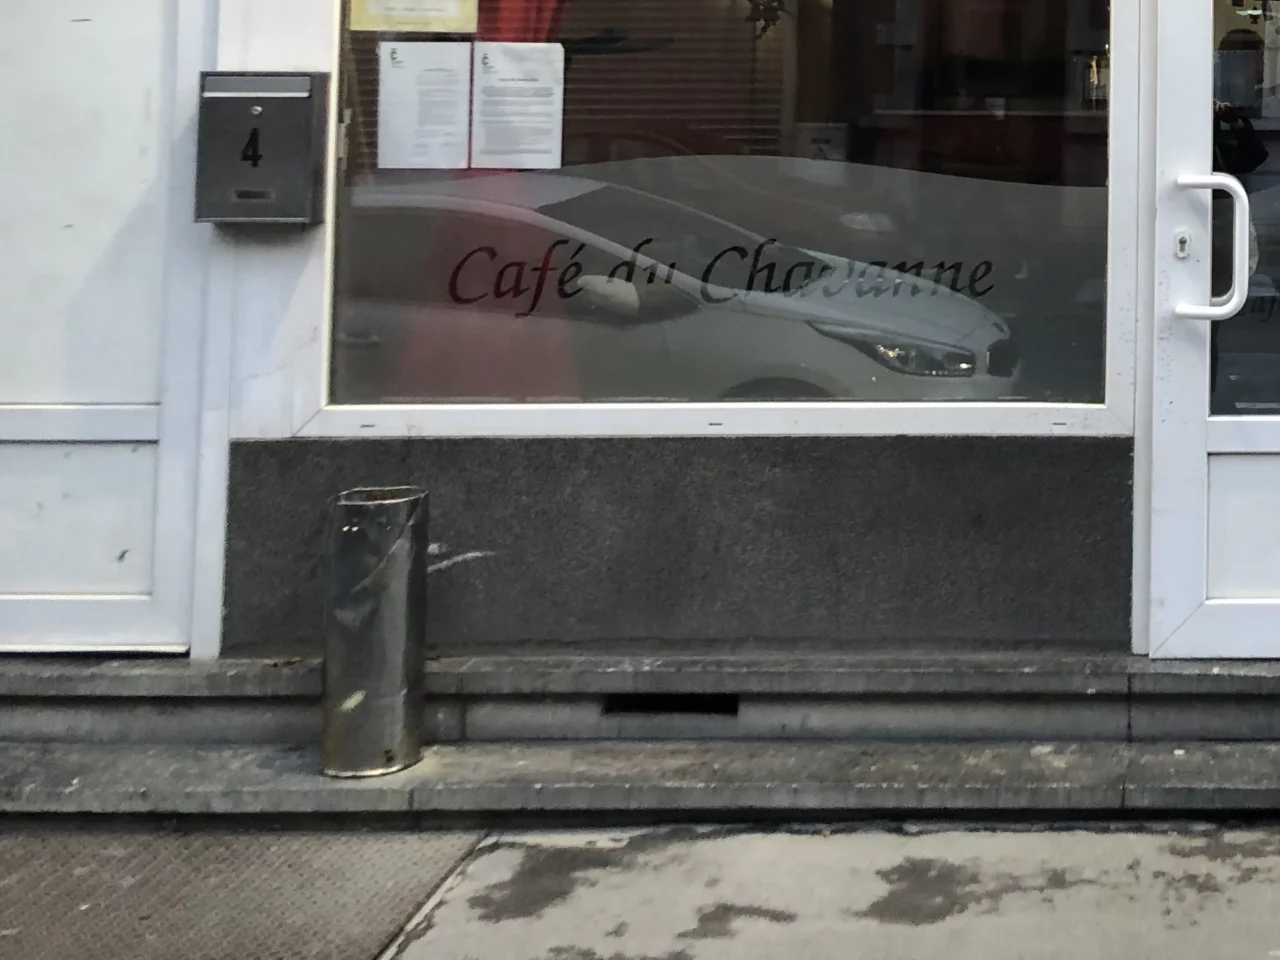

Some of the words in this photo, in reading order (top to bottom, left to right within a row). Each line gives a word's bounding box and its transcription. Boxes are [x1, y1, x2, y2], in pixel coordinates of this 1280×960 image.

[240, 127, 263, 168] 4
[448, 239, 587, 319] Café
[606, 237, 677, 291] du
[701, 238, 995, 303] Chavanne
